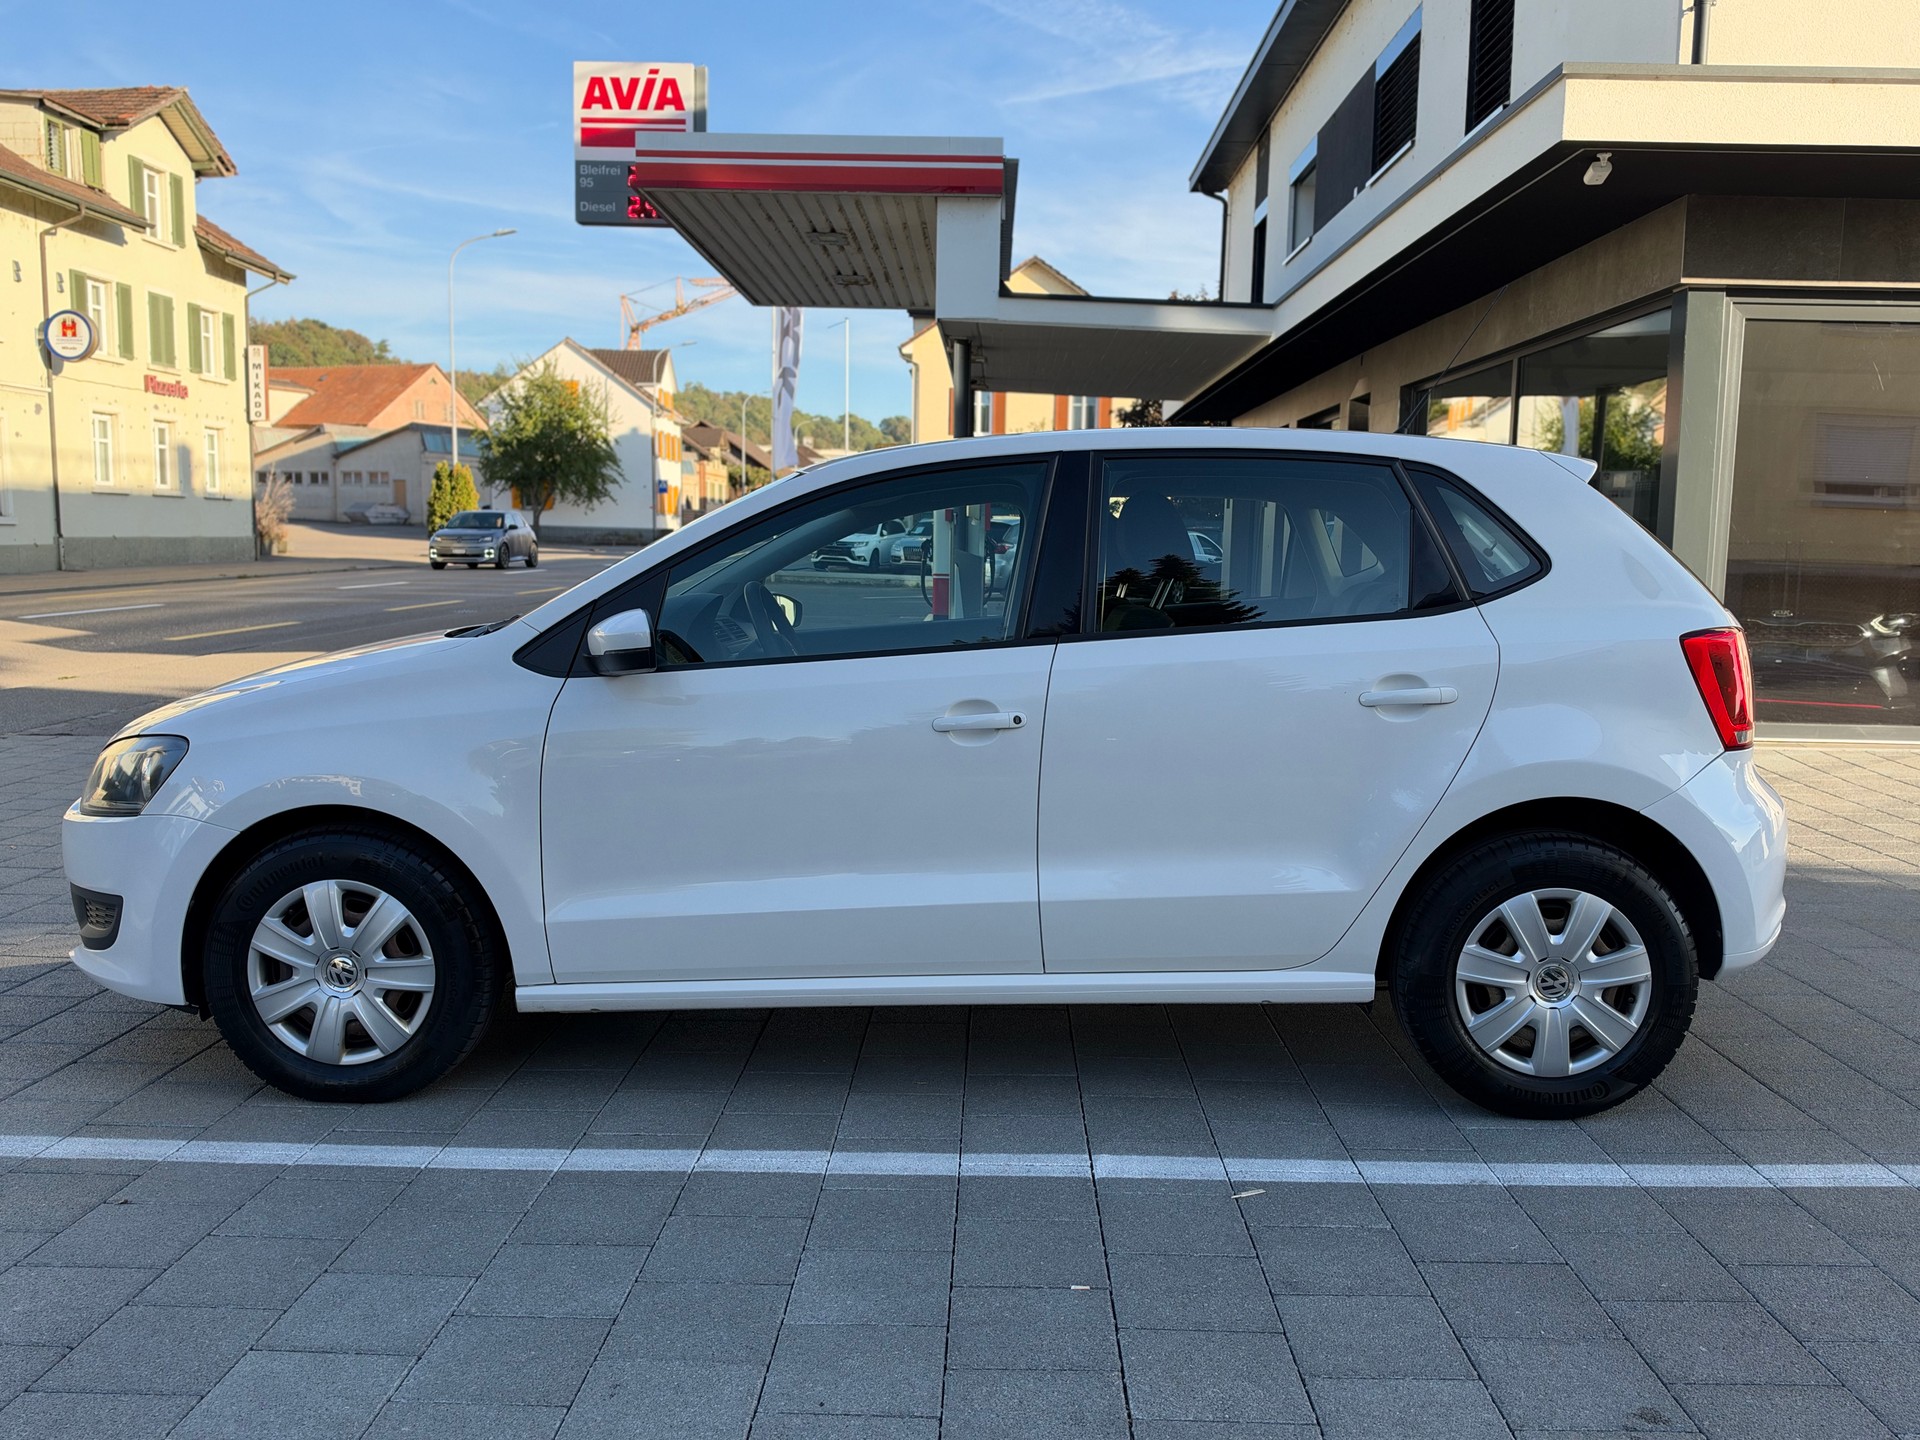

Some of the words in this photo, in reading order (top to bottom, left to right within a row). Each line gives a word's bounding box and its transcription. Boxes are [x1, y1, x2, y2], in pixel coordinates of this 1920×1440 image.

[579, 164, 621, 176] Bleifrei
[579, 178, 594, 188] 95
[579, 201, 616, 212] Diesel
[143, 374, 189, 399] Pizzeria
[252, 362, 263, 419] MIKADO
